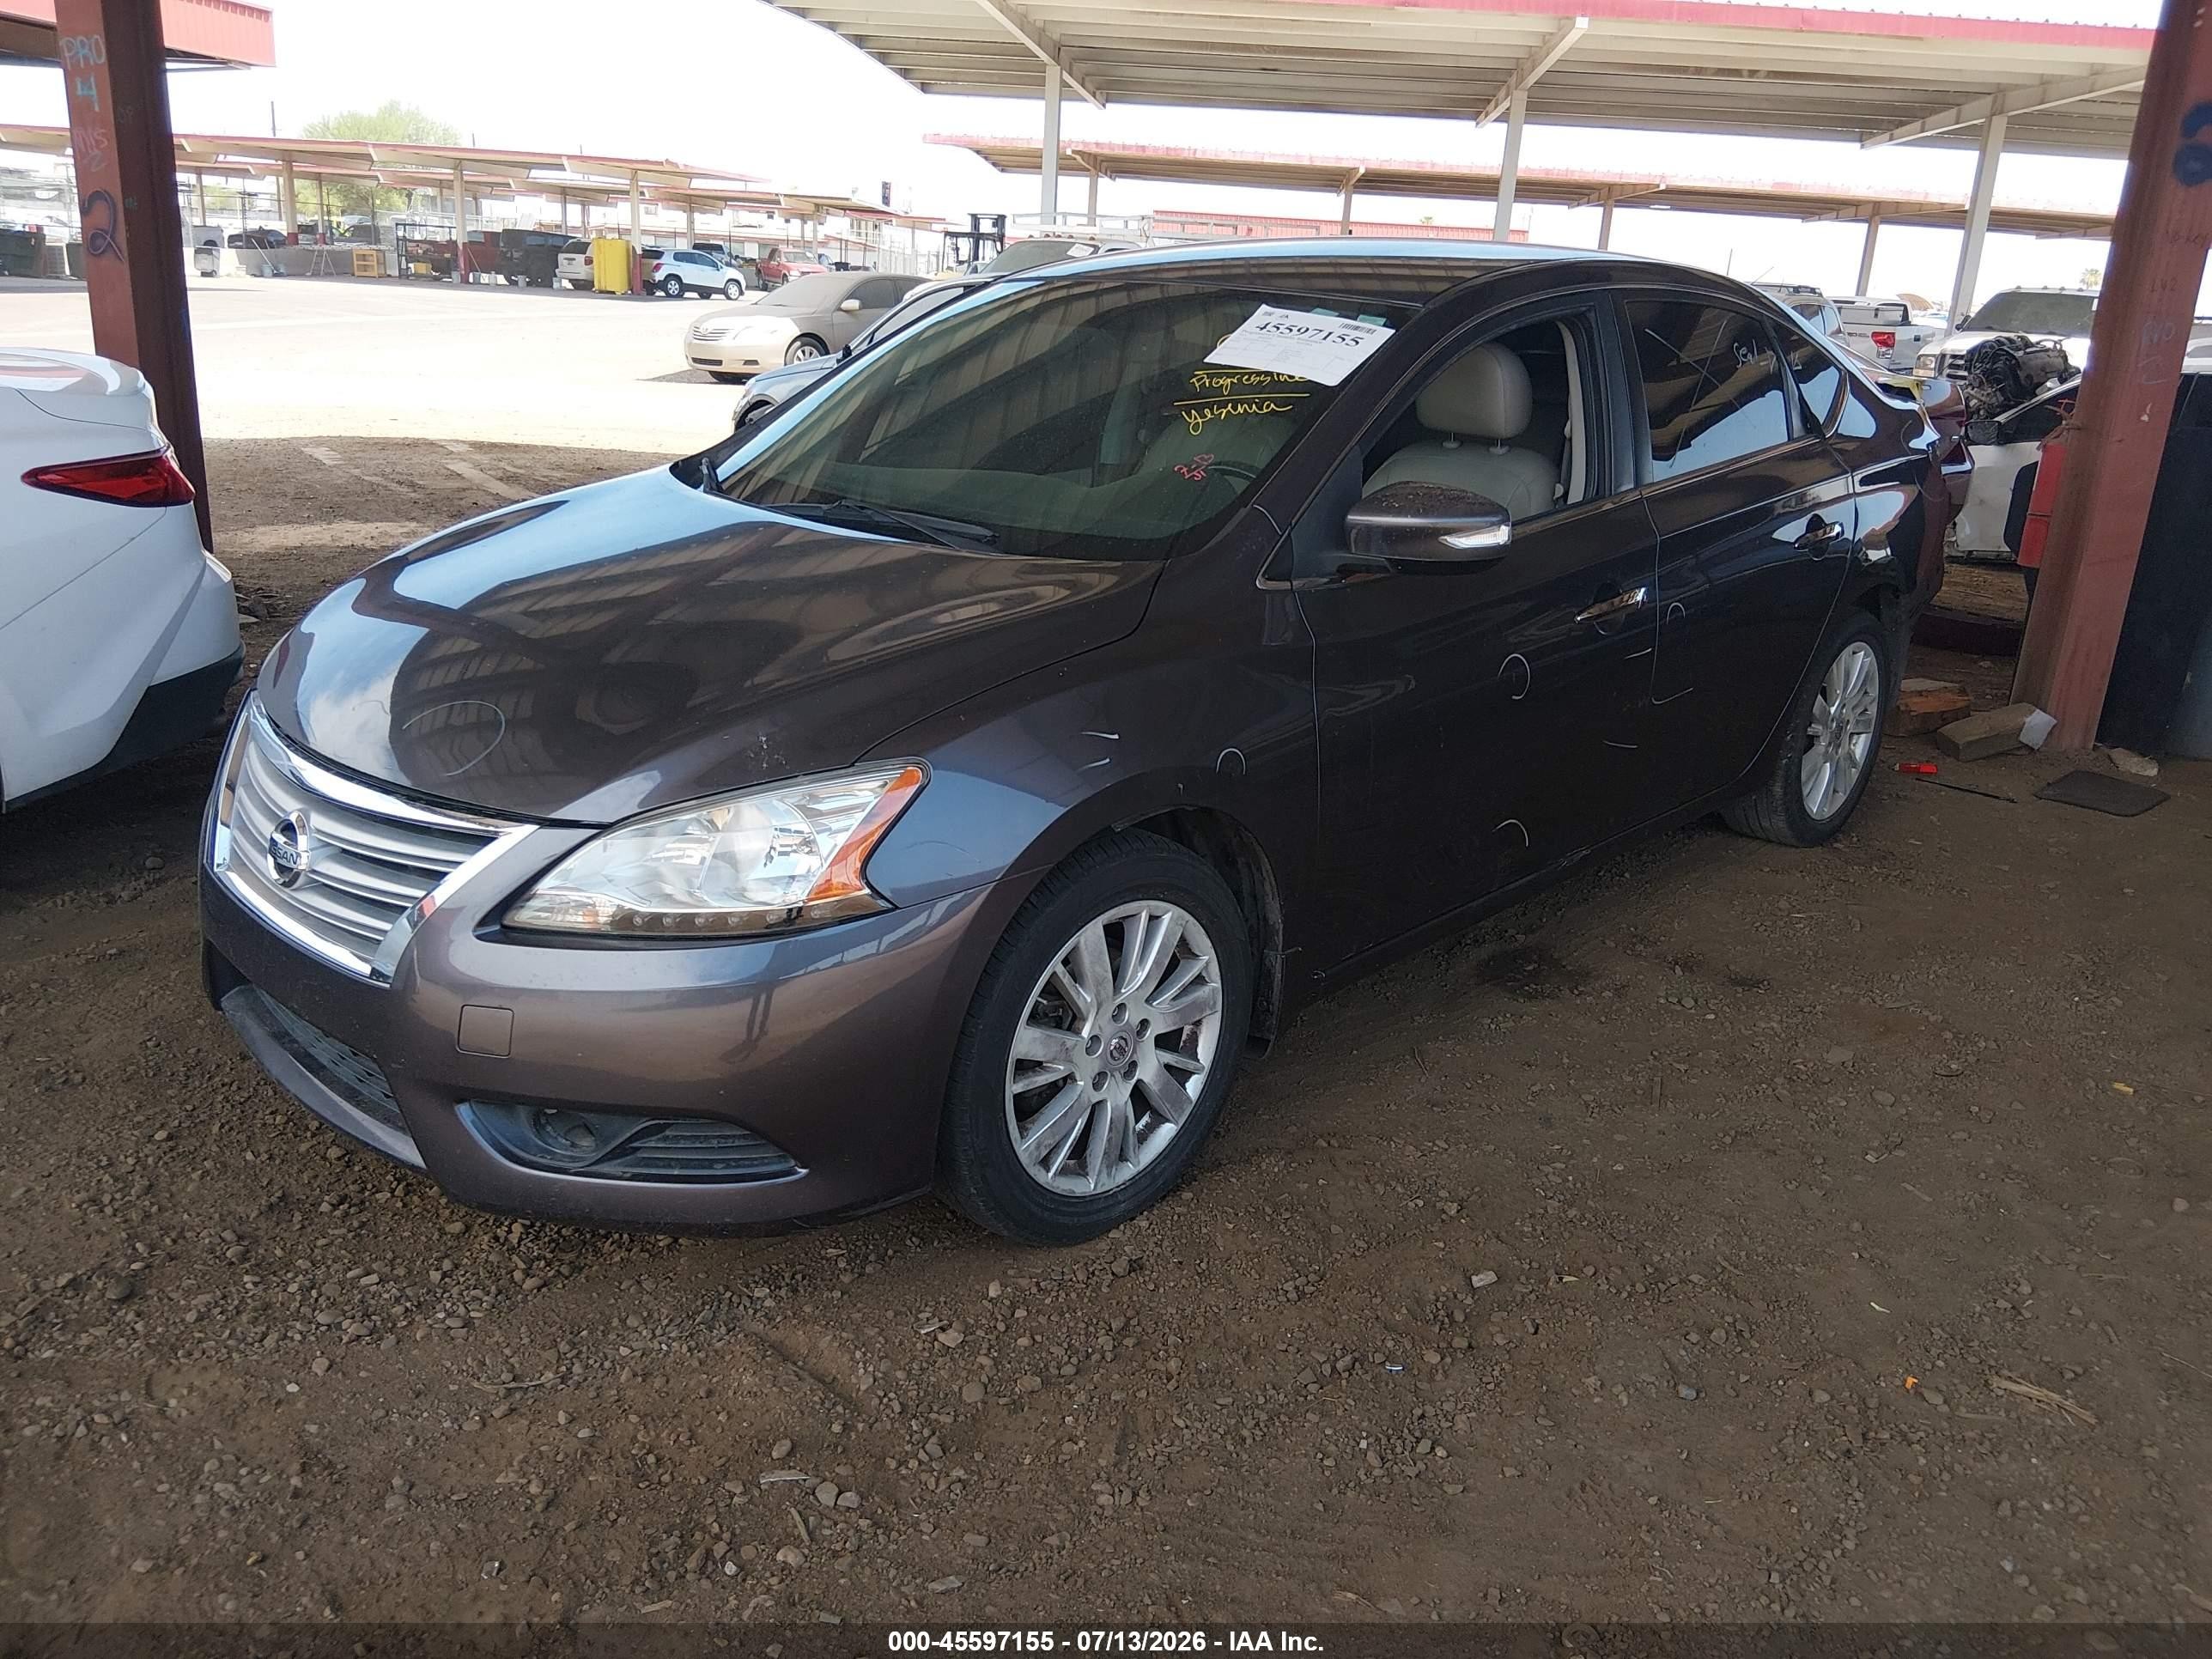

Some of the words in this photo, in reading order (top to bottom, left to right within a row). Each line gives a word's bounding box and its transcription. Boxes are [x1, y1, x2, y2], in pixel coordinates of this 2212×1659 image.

[59, 35, 107, 70] PRO
[76, 73, 100, 112] 4
[83, 188, 125, 262] 2
[1255, 322, 1365, 347] 45597155
